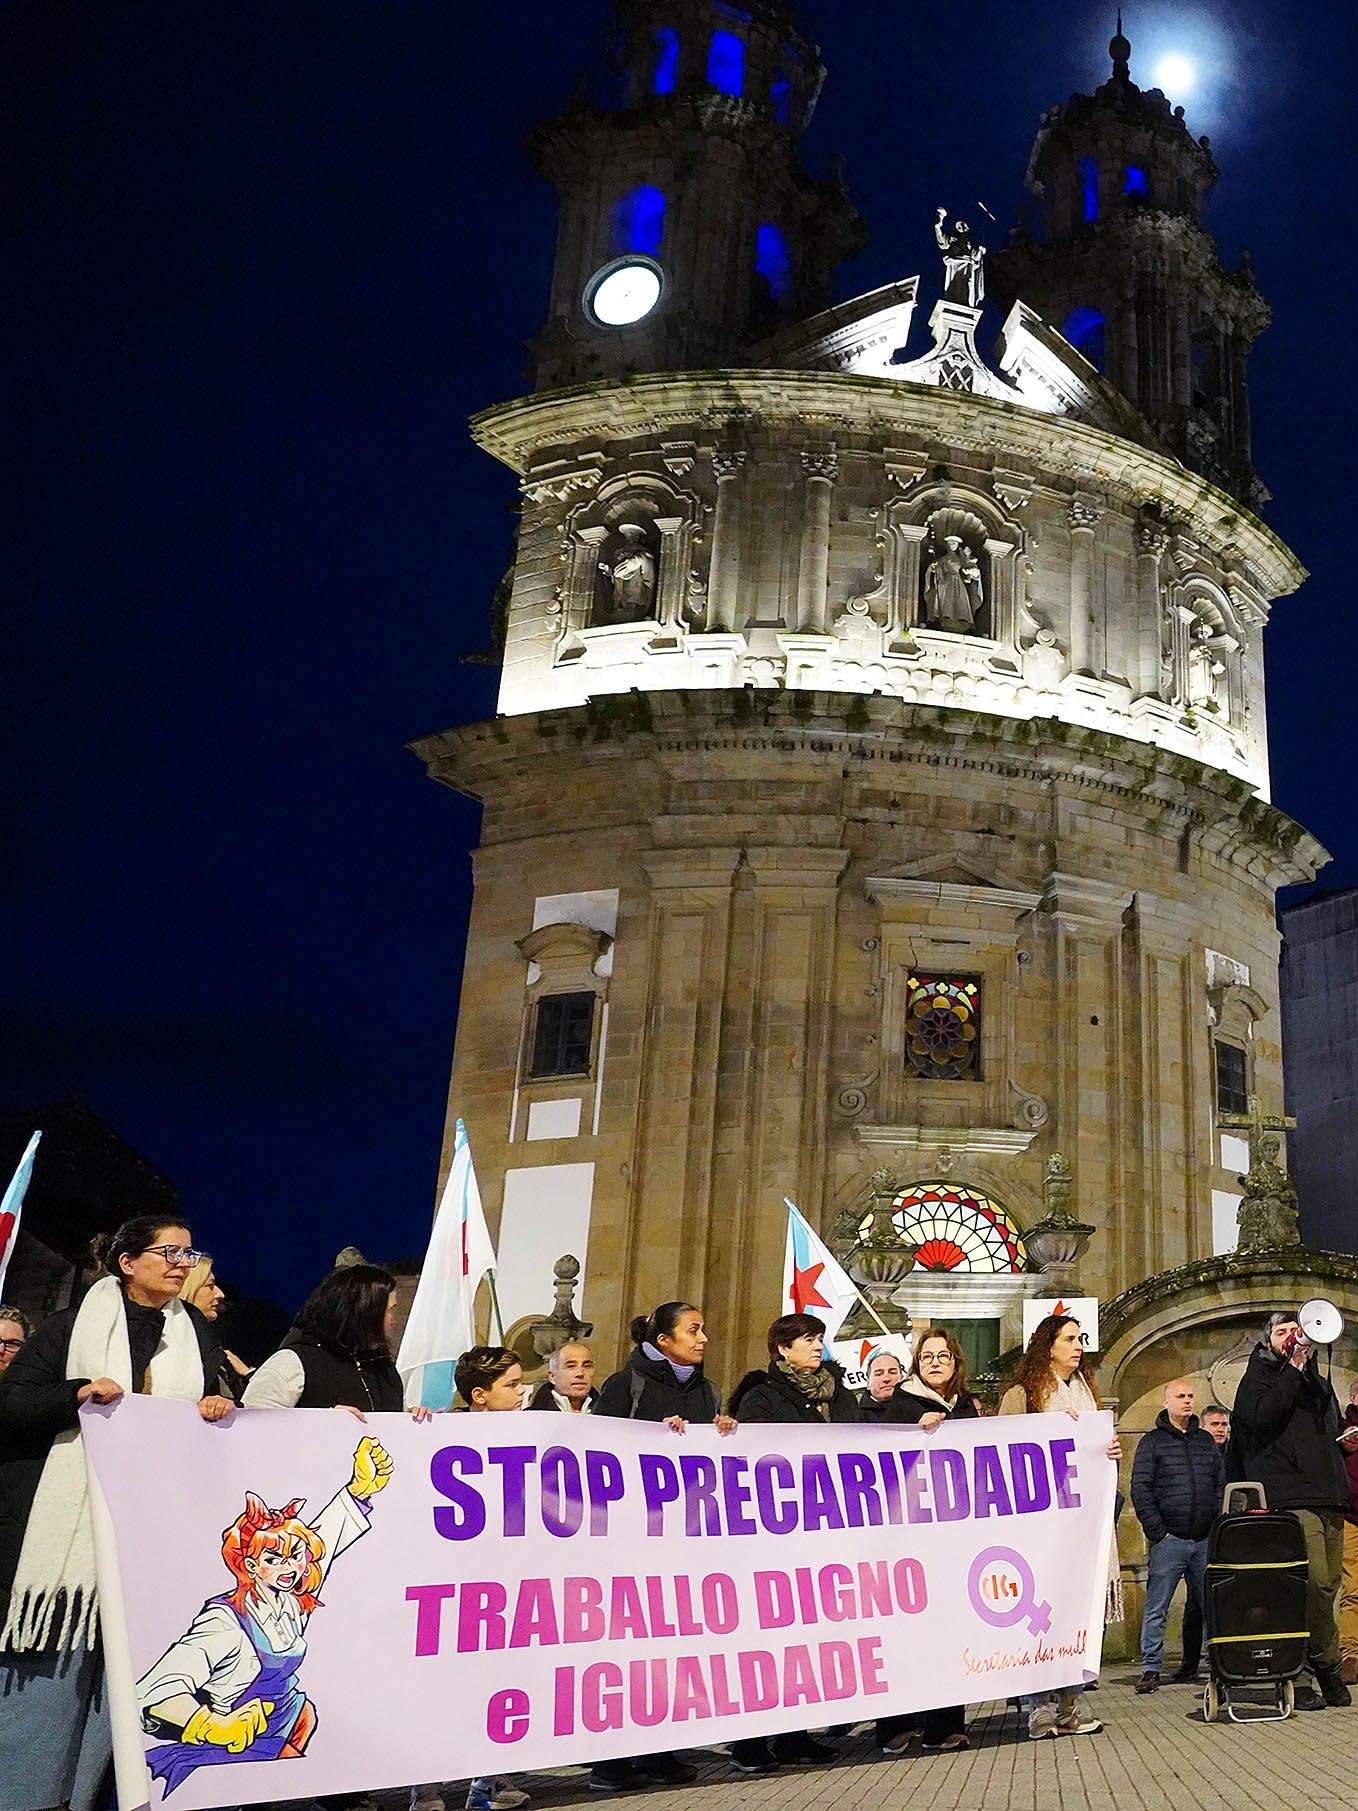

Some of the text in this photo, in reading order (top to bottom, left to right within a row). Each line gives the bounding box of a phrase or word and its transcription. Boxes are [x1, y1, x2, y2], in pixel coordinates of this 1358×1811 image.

[430, 1438, 1082, 1541] STOP PRECARIEDADE
[405, 1557, 929, 1657] TRABALLO DIGNO
[982, 1574, 1018, 1600] CIG
[486, 1635, 889, 1744] e IGUALDADE
[1058, 1629, 1088, 1660] mull
